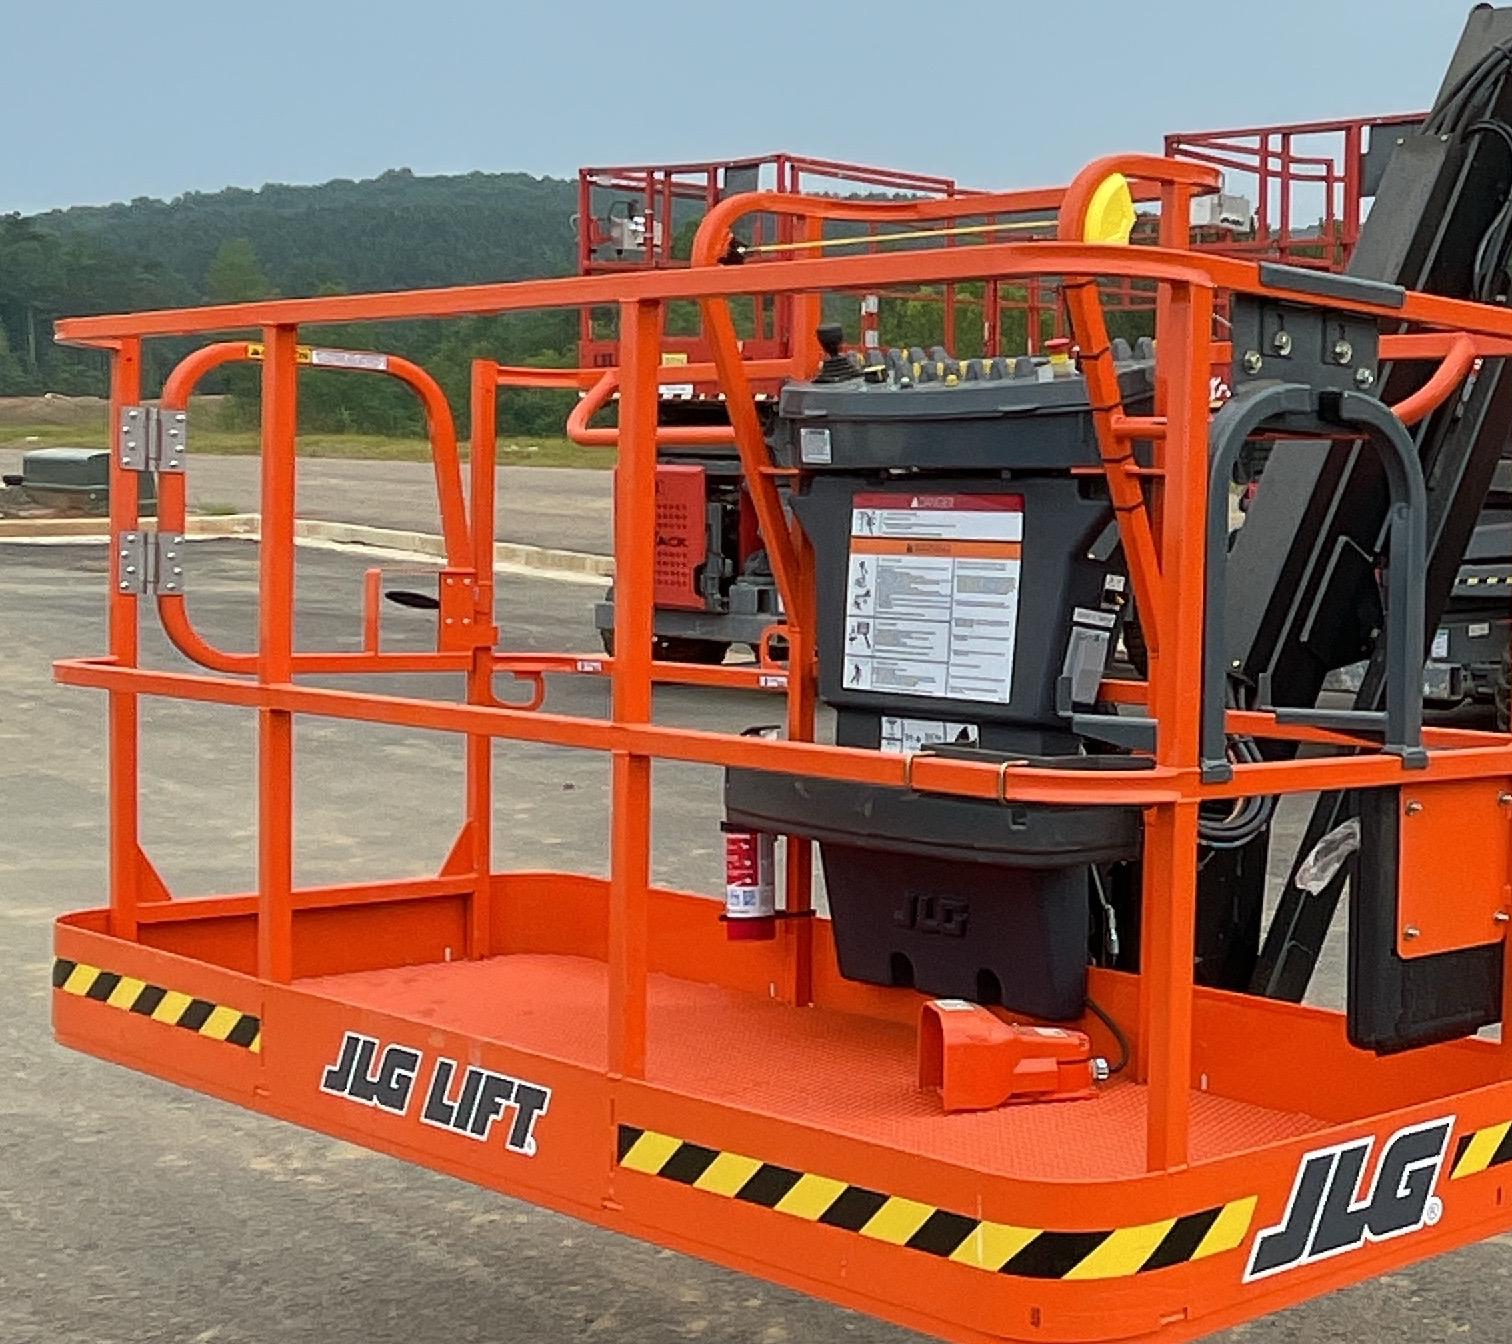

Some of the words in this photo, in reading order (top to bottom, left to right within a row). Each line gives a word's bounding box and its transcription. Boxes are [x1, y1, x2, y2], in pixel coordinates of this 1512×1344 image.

[320, 1031, 423, 1117] JLG
[419, 1056, 552, 1156] LIFT
[1241, 1114, 1457, 1284] JLG
